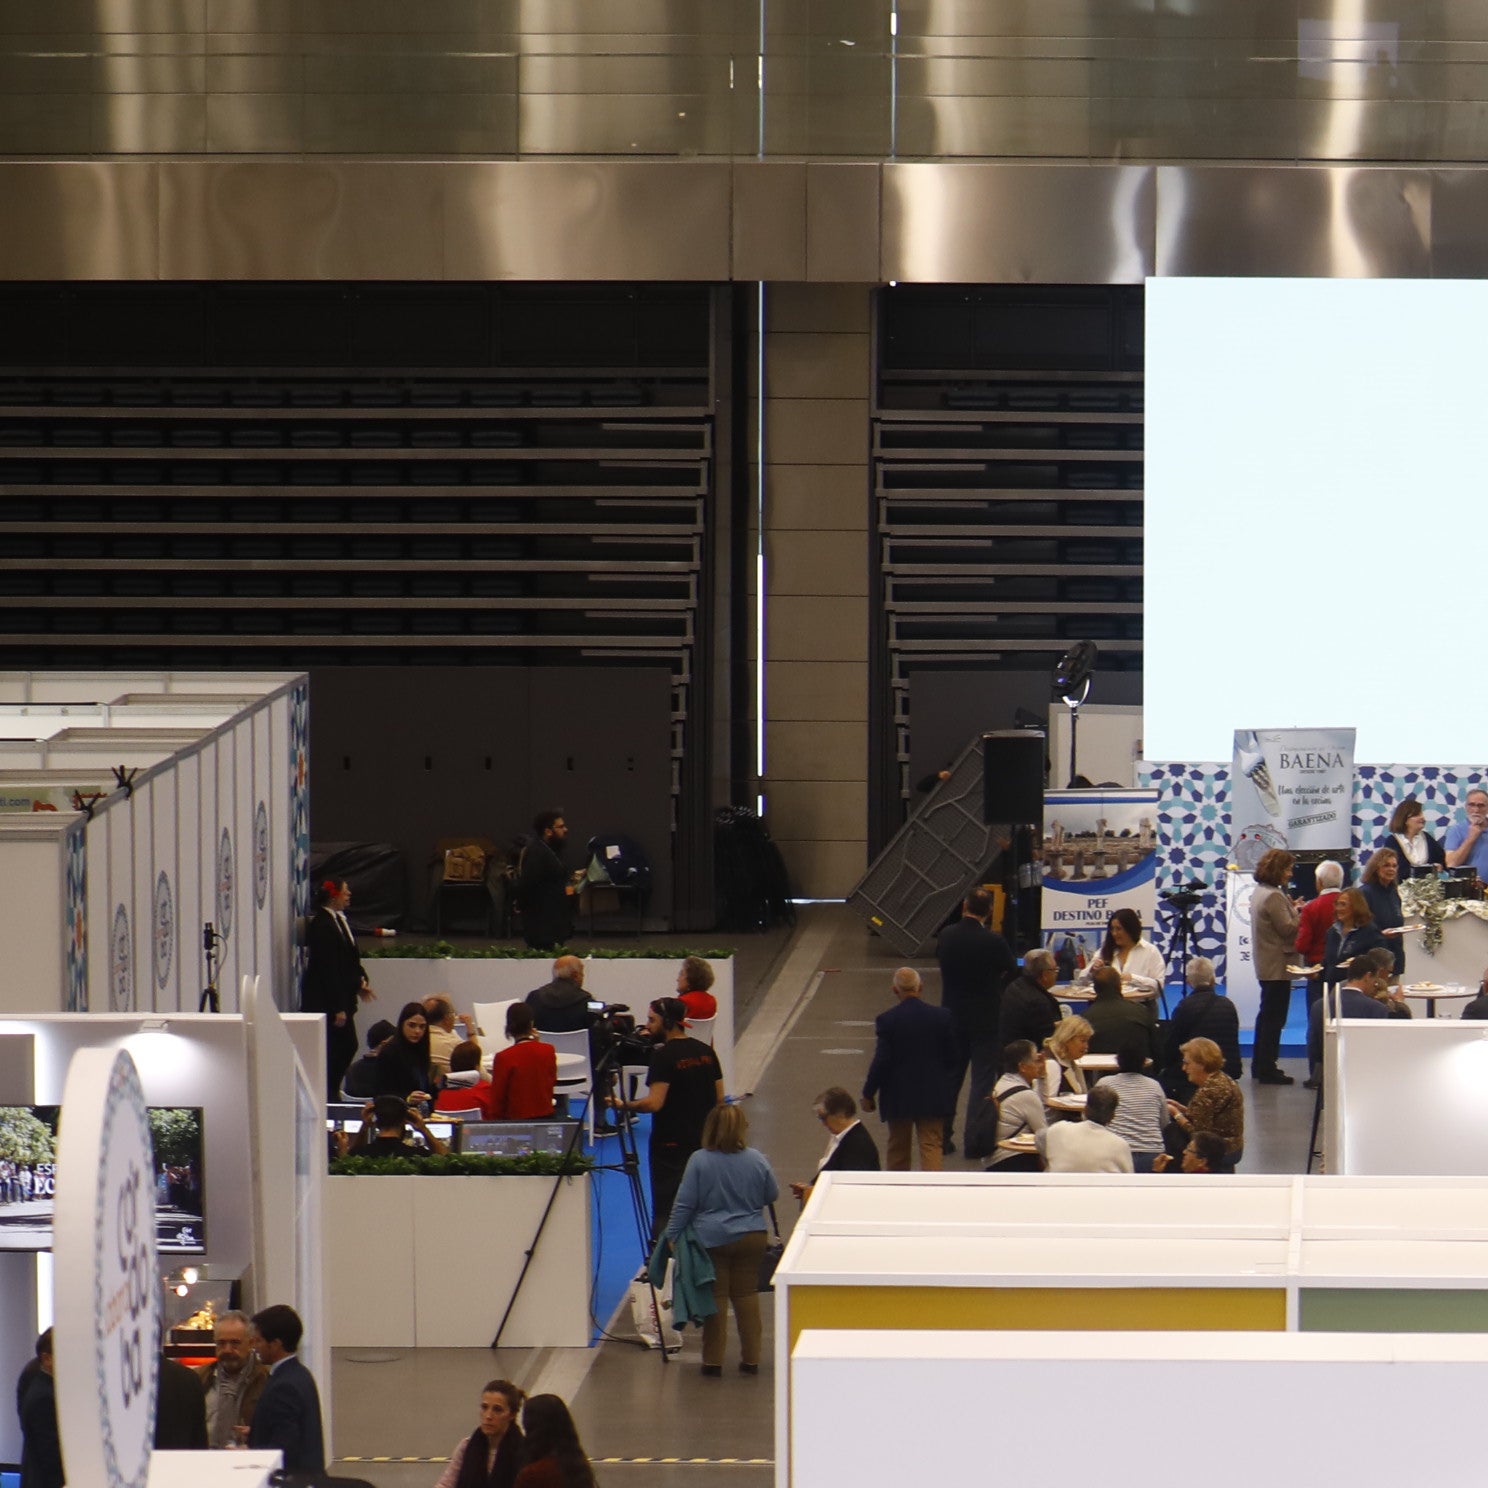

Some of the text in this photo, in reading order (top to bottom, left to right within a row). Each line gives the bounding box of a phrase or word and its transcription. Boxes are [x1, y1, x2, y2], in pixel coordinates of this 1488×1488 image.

[1280, 752, 1345, 769] BAENA
[1088, 898, 1109, 909] PEF
[1053, 909, 1103, 922] DESTINO
